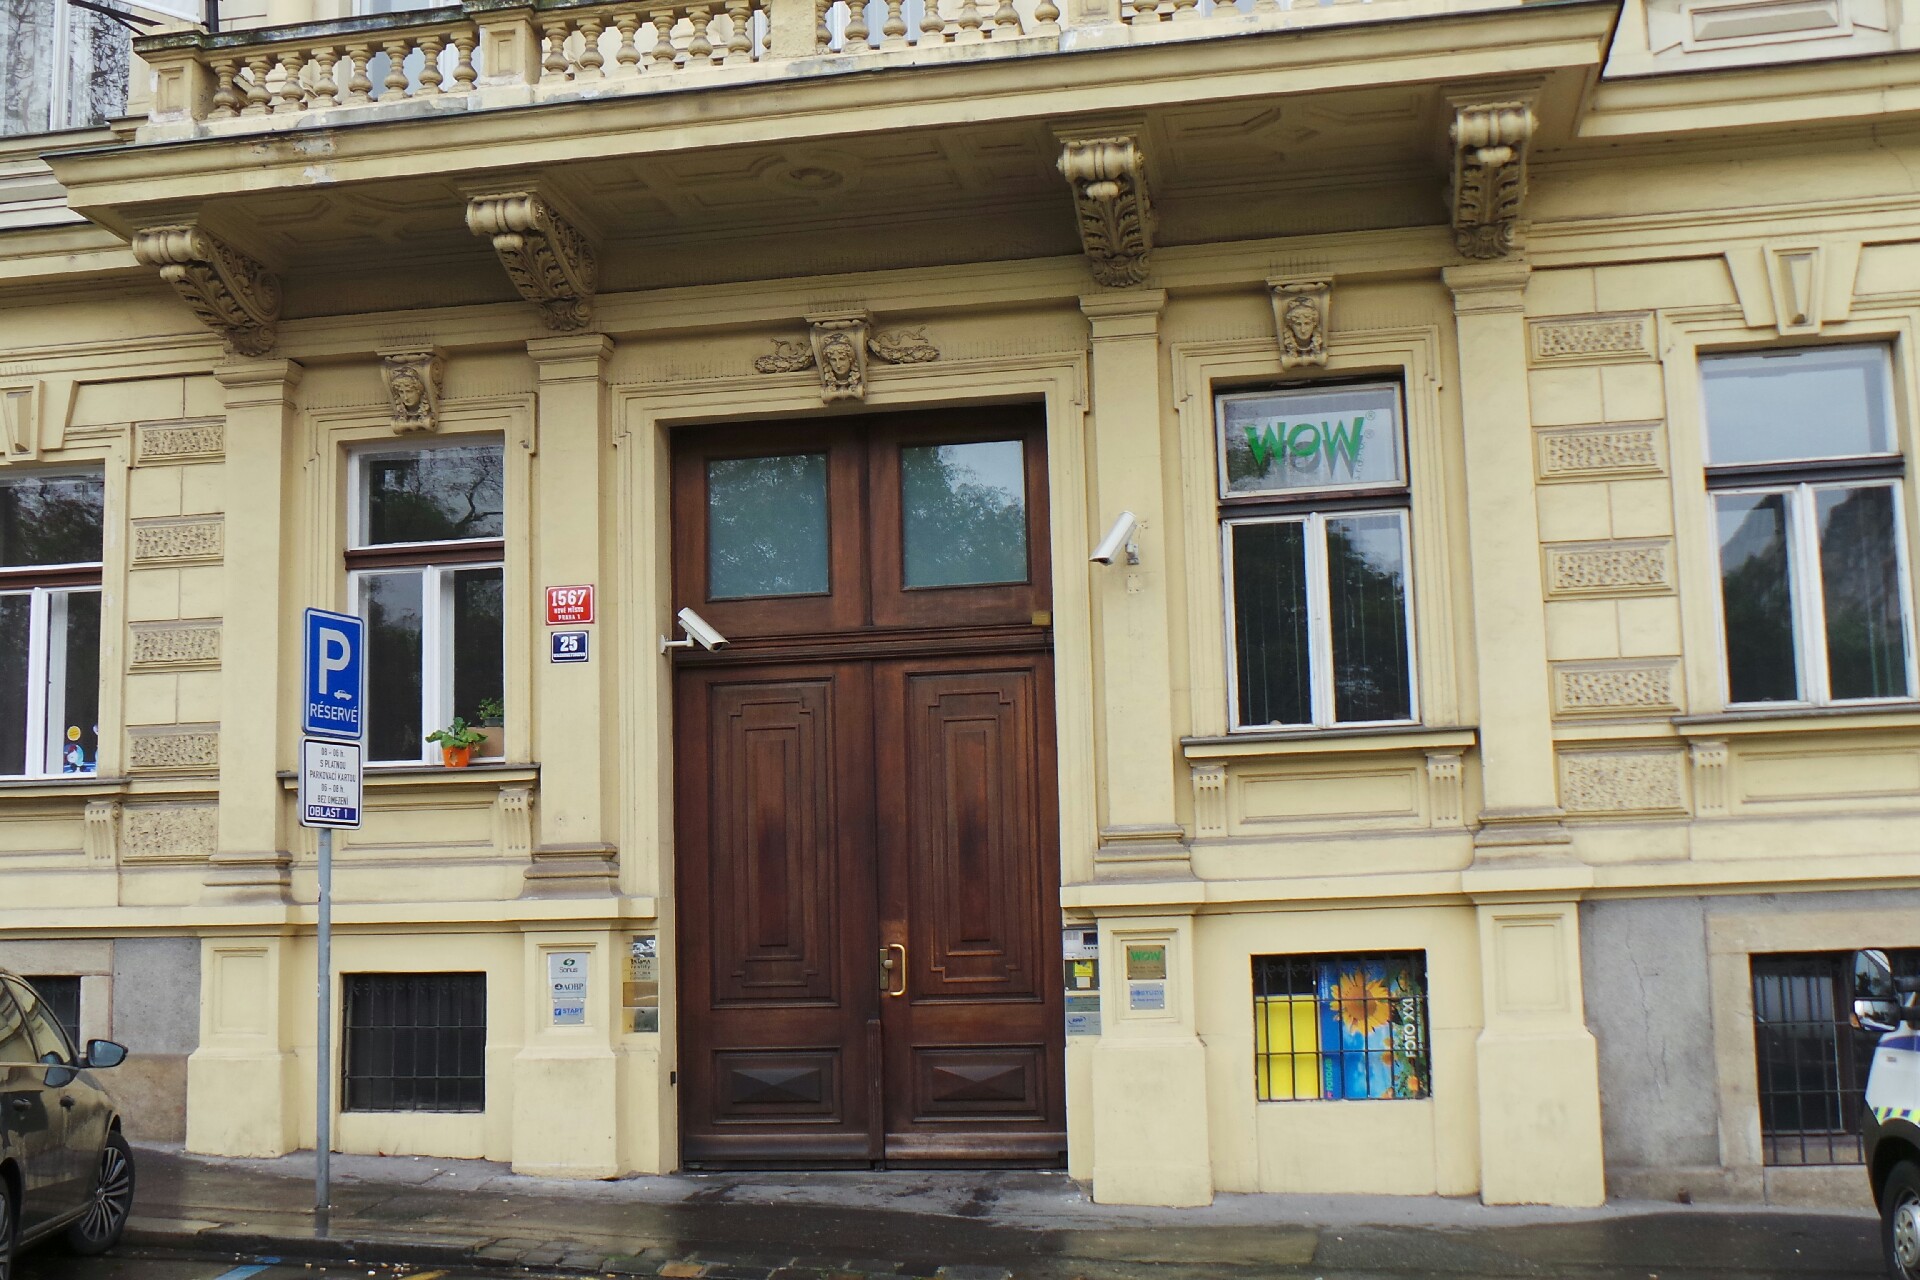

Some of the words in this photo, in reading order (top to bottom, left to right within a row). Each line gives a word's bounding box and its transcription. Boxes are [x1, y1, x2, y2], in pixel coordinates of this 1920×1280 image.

[1244, 417, 1364, 466] WOW
[552, 589, 586, 606] 1567
[560, 636, 578, 651] 25
[319, 627, 350, 694] P
[310, 701, 358, 723] RÉSERVÉ
[309, 806, 341, 818] OBLAST
[344, 809, 348, 818] 1
[1131, 951, 1161, 961] WOW
[1403, 998, 1414, 1020] XXI
[1403, 1023, 1416, 1057] FOTO
